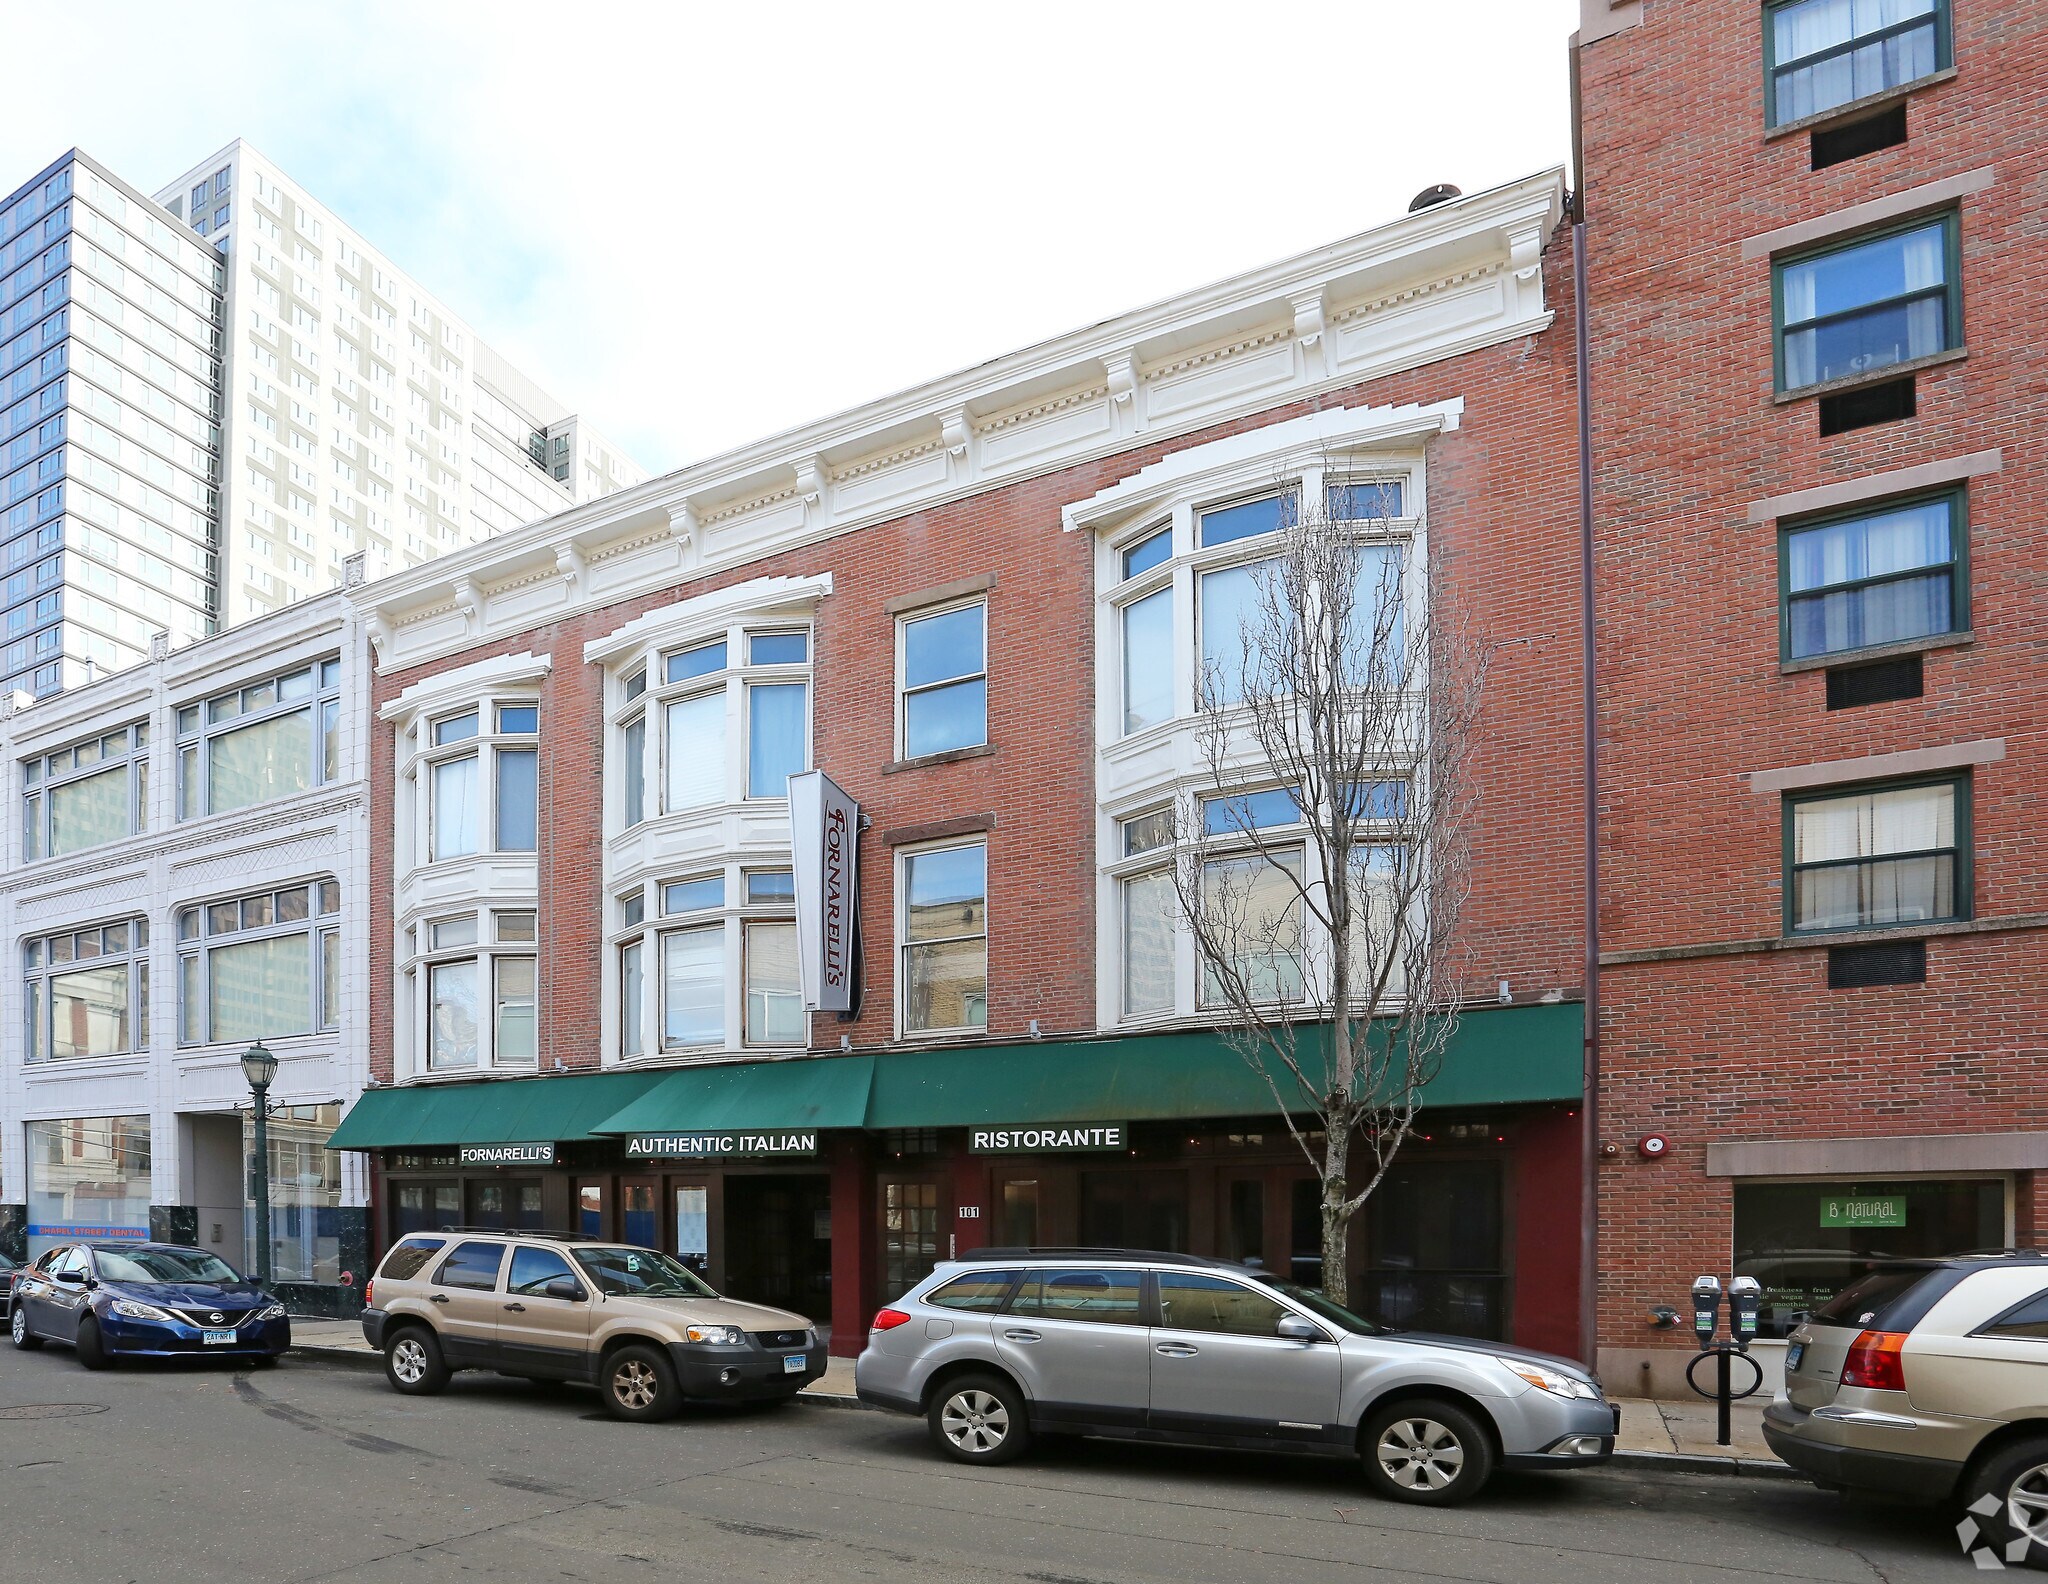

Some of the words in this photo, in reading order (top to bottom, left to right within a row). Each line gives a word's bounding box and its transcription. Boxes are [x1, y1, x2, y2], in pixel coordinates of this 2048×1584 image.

[827, 807, 846, 987] FORNARELLI'S
[628, 1136, 734, 1154] AUTHENTIC
[738, 1134, 816, 1152] ITALIAN
[974, 1128, 1120, 1149] RISTORANTE
[460, 1146, 552, 1162] FORNARELLI'S
[960, 1207, 978, 1217] 101
[1829, 1202, 1839, 1218] B
[39, 1227, 72, 1235] CHAPEL
[74, 1228, 107, 1236] STREET
[109, 1228, 146, 1237] DENTAL
